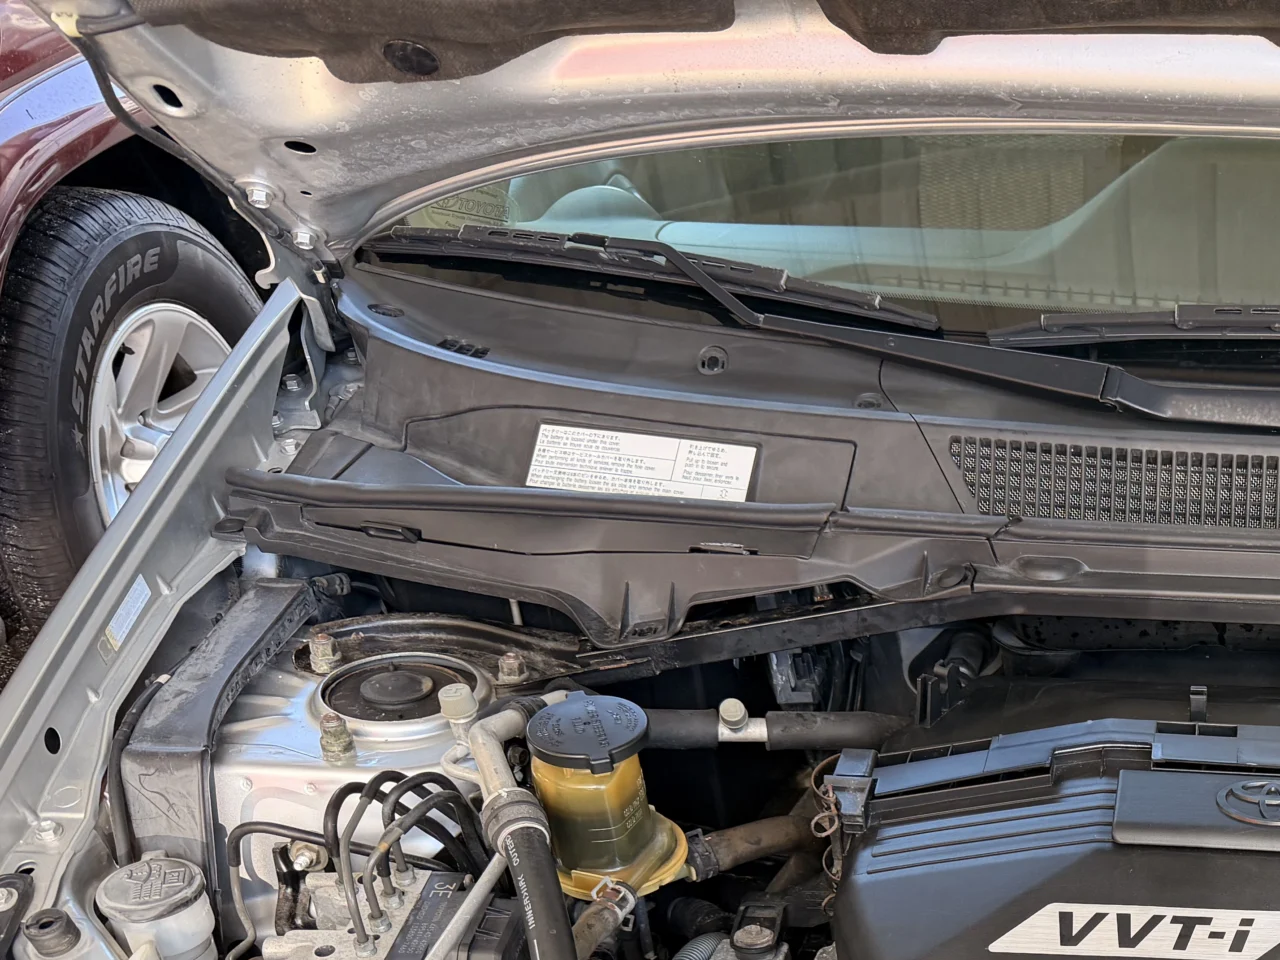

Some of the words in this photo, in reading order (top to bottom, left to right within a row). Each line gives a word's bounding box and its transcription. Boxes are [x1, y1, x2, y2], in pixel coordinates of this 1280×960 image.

[458, 198, 510, 219] TOYOTA
[71, 247, 160, 416] STARFIRE
[429, 882, 456, 899] 3E
[1058, 911, 1255, 953] VVT-i
